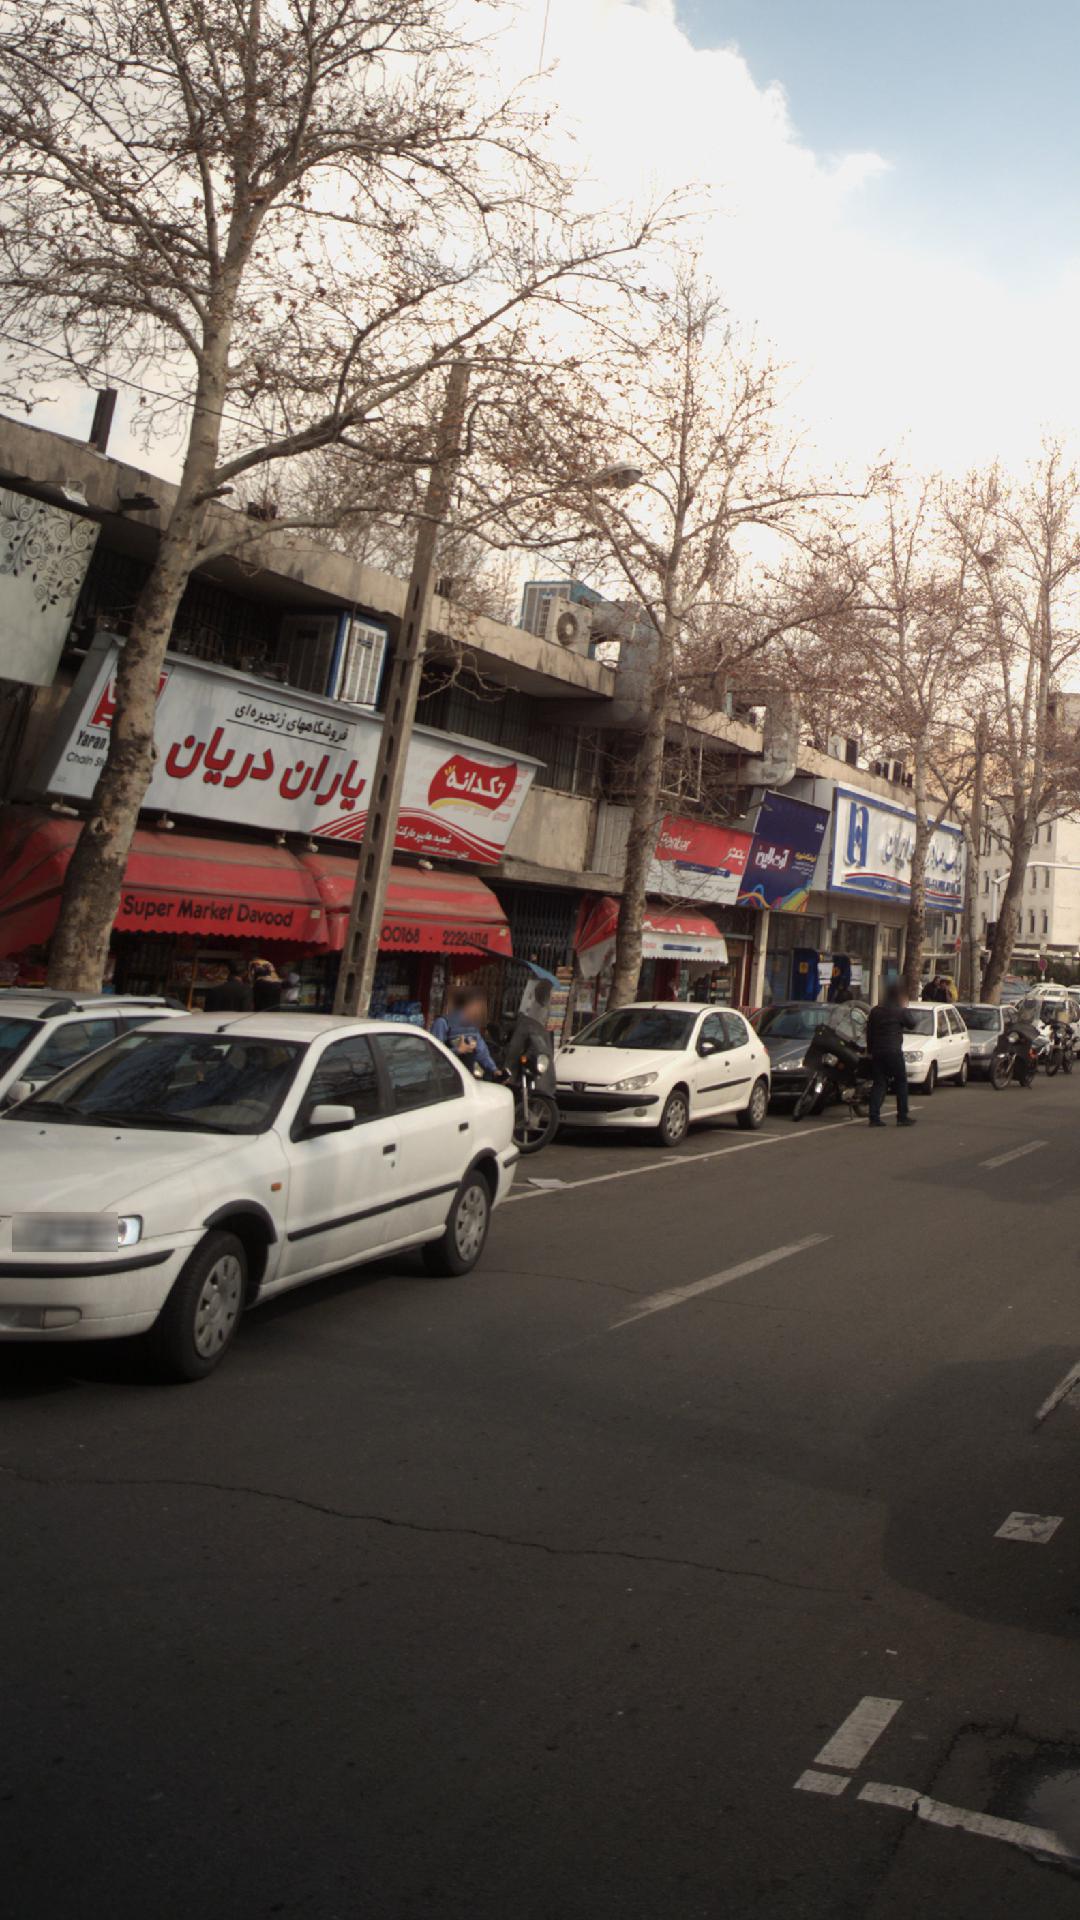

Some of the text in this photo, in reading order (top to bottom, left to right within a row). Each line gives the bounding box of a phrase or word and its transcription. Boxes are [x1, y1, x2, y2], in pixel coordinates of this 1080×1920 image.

[165, 726, 367, 811] یاران دریان
[122, 895, 293, 927] Super Market Davood
